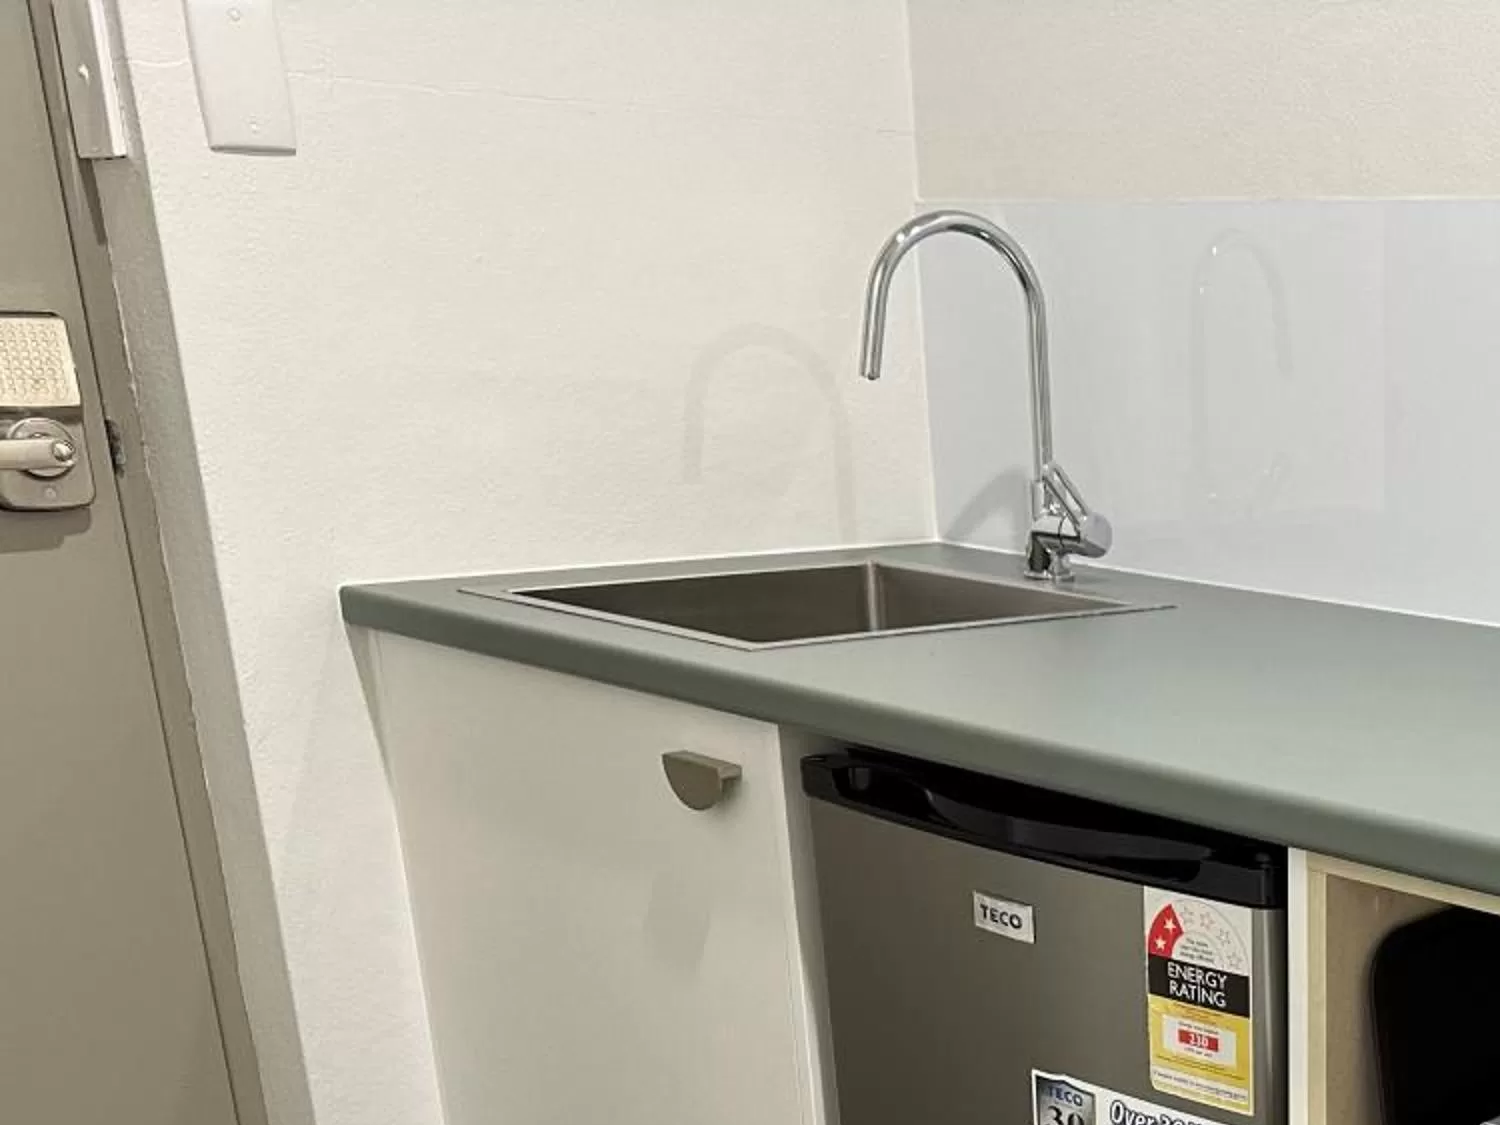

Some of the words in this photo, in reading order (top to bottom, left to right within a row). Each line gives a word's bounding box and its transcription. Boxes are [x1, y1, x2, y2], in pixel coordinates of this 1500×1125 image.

[980, 903, 1022, 929] TECO
[1167, 961, 1227, 988] ENERGY
[1169, 979, 1226, 1007] RATING
[1048, 1085, 1083, 1107] TECO
